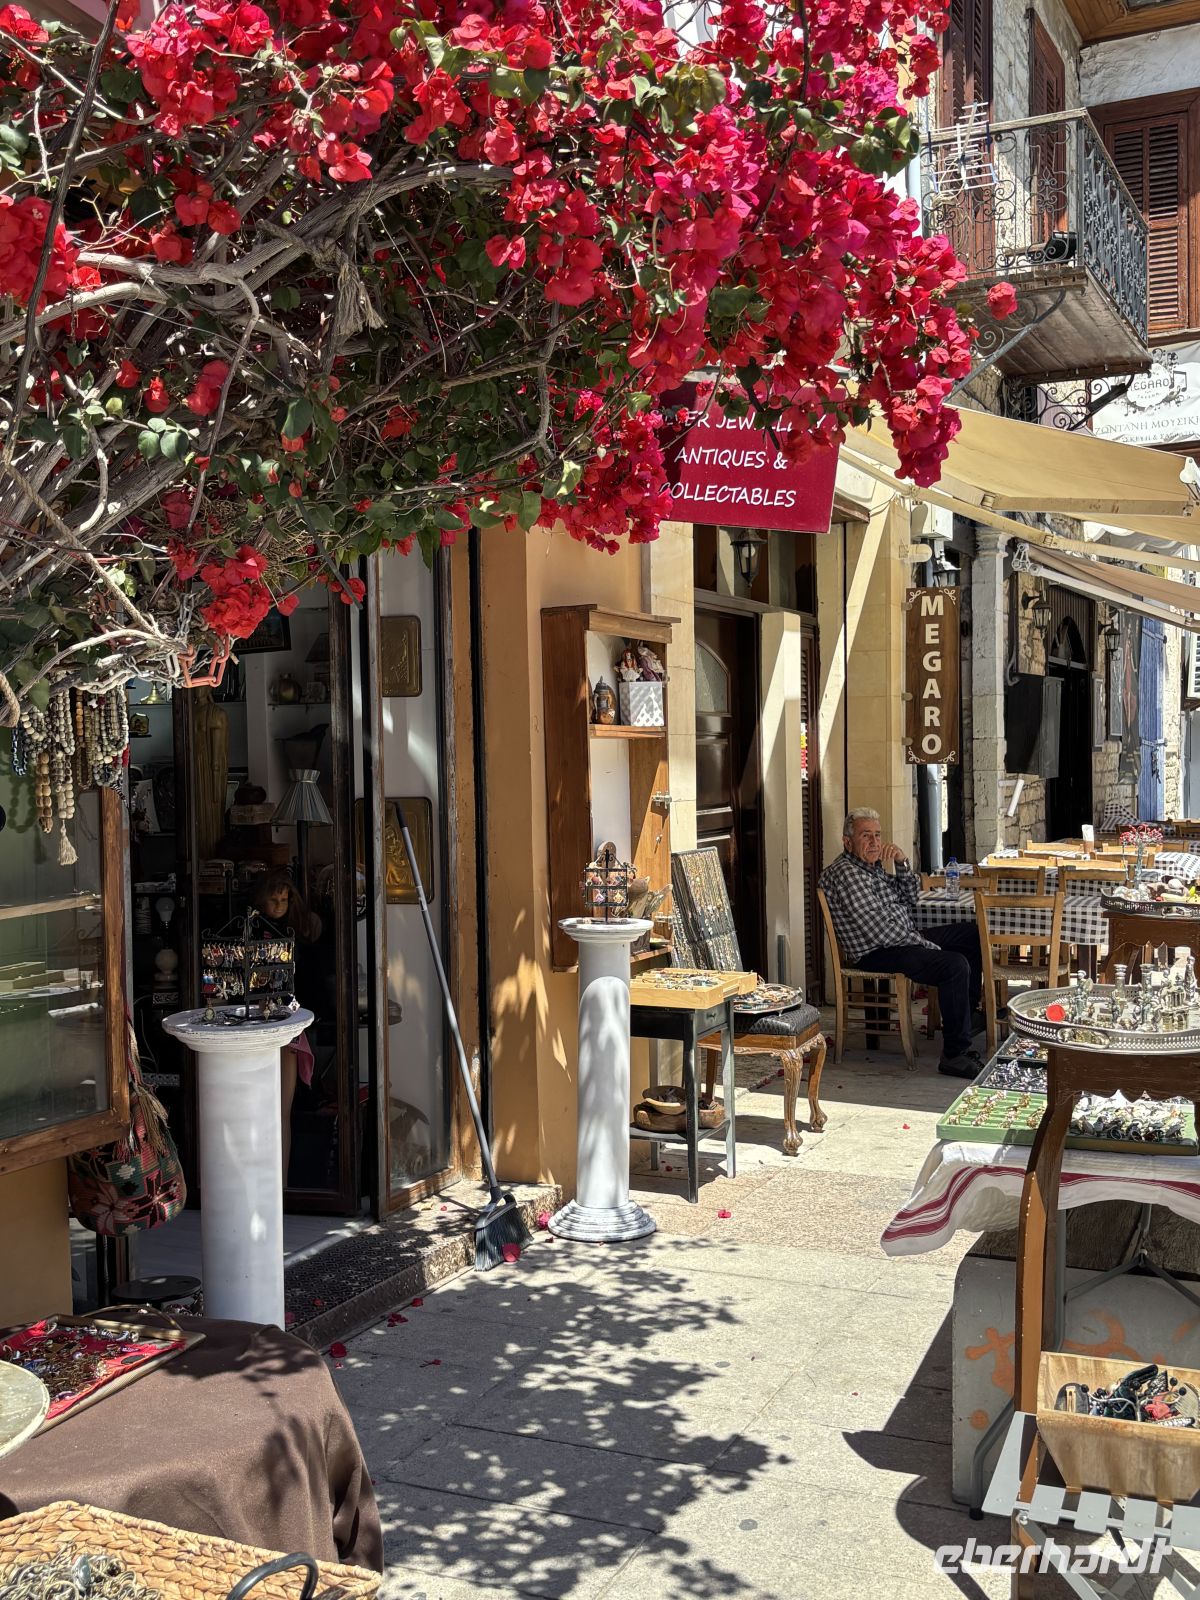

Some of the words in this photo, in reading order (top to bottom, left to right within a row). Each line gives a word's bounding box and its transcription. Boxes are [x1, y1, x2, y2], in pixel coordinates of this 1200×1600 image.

[674, 446, 766, 469] ANTIQUES
[773, 451, 788, 470] &
[921, 595, 944, 755] MEGARO
